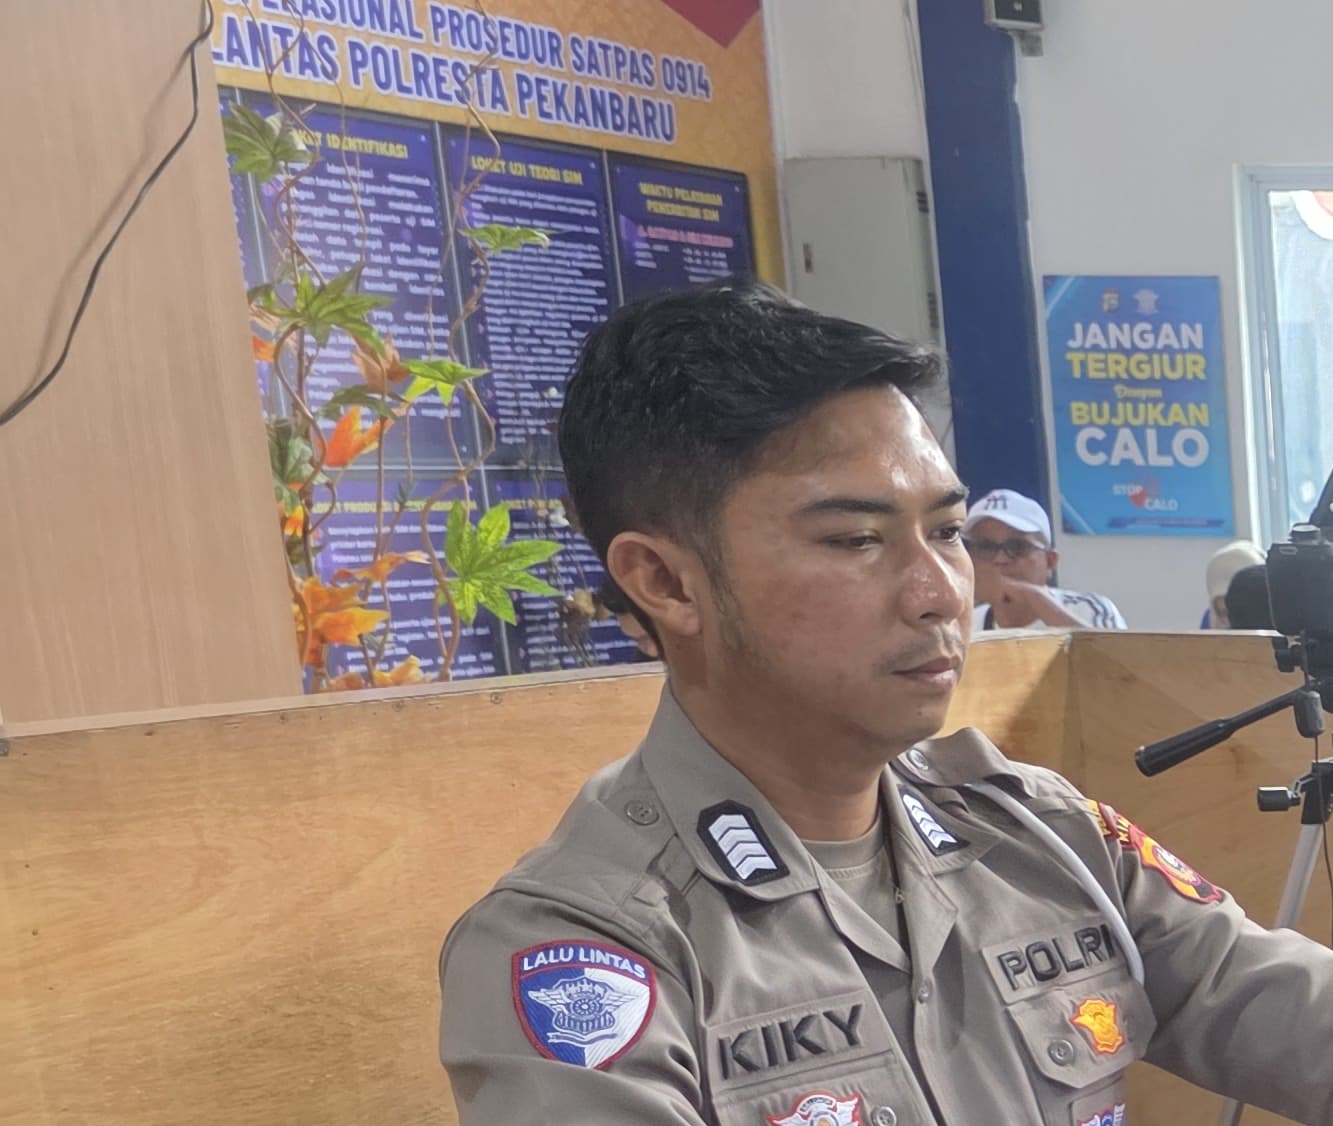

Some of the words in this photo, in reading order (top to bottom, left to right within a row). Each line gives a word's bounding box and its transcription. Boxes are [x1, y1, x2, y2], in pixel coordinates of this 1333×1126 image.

[429, 4, 565, 70] PROSEDUR
[570, 36, 656, 88] SATPAS
[662, 57, 712, 99] 0914
[348, 40, 510, 113] POLRESTA
[516, 72, 676, 143] PEKANBARU
[1067, 322, 1204, 349] JANGAN
[1065, 352, 1206, 380] TERGIUR
[1071, 401, 1210, 426] BUJUKAN
[1076, 427, 1210, 468] CALO
[1112, 484, 1143, 496] STOP
[1144, 499, 1178, 511] CALO
[523, 947, 574, 971] LALU
[579, 947, 646, 979] LINTAS
[998, 924, 1115, 991] POLRI
[718, 1004, 862, 1080] KIKY
